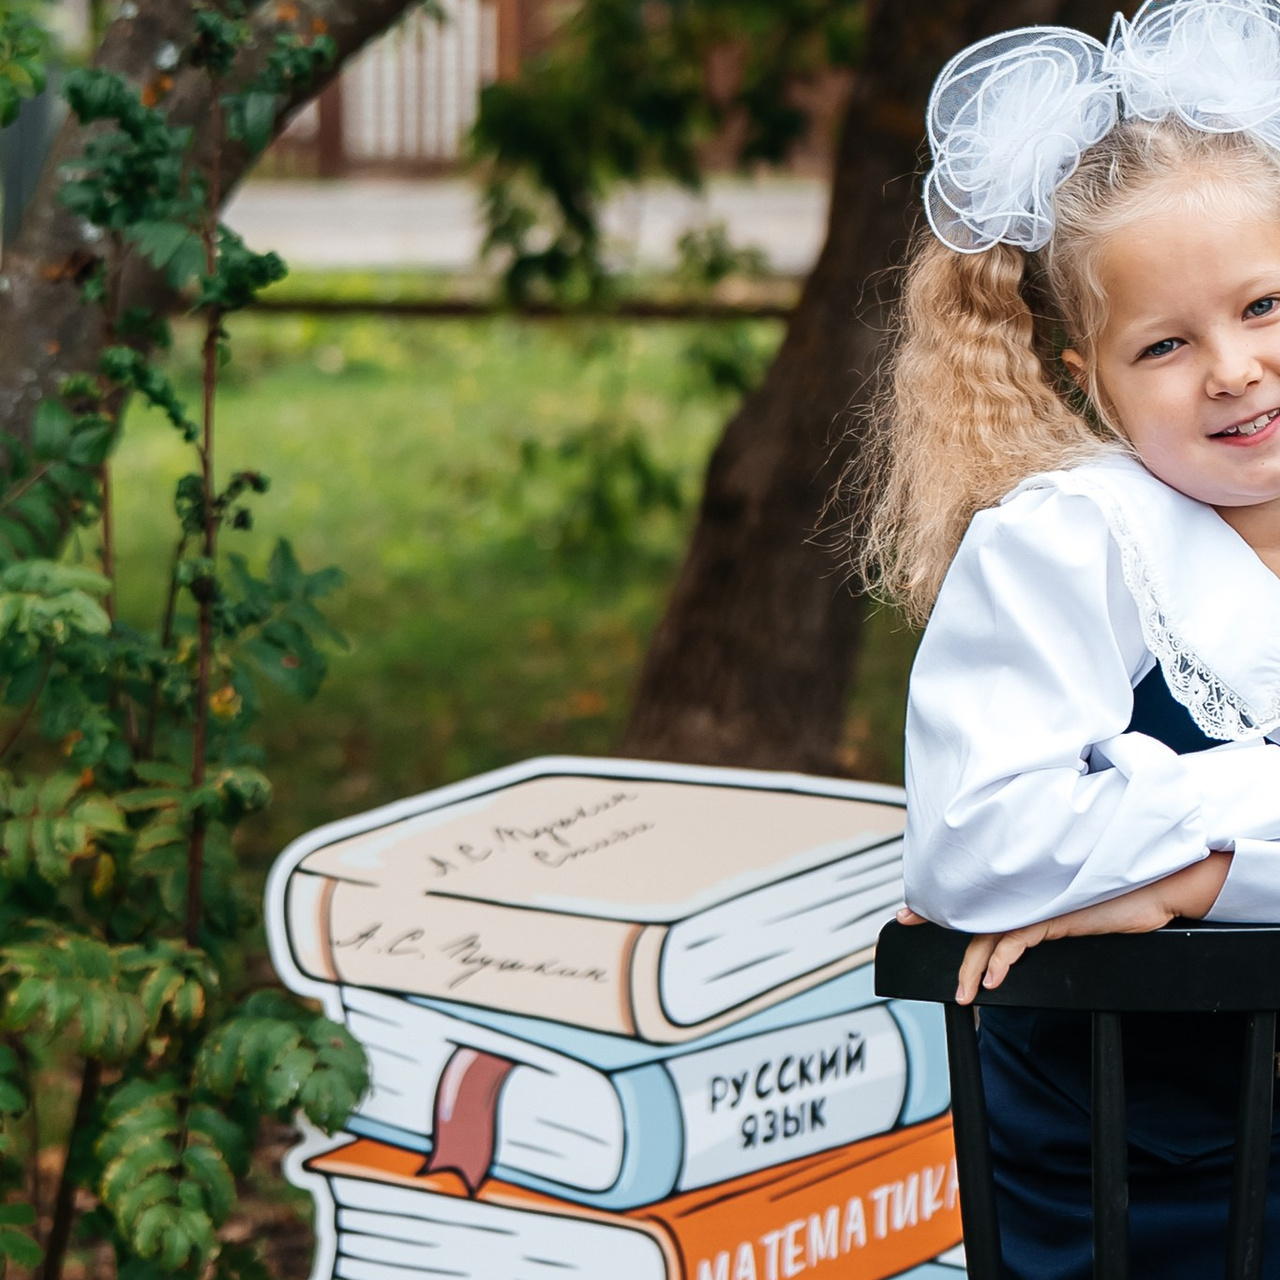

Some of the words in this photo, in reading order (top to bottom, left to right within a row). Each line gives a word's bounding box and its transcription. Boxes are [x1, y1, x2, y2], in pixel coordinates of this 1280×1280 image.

[441, 931, 610, 989] Пушкин
[710, 1031, 868, 1111] РУССКИЙ
[740, 1096, 828, 1150] ЯЗЫК
